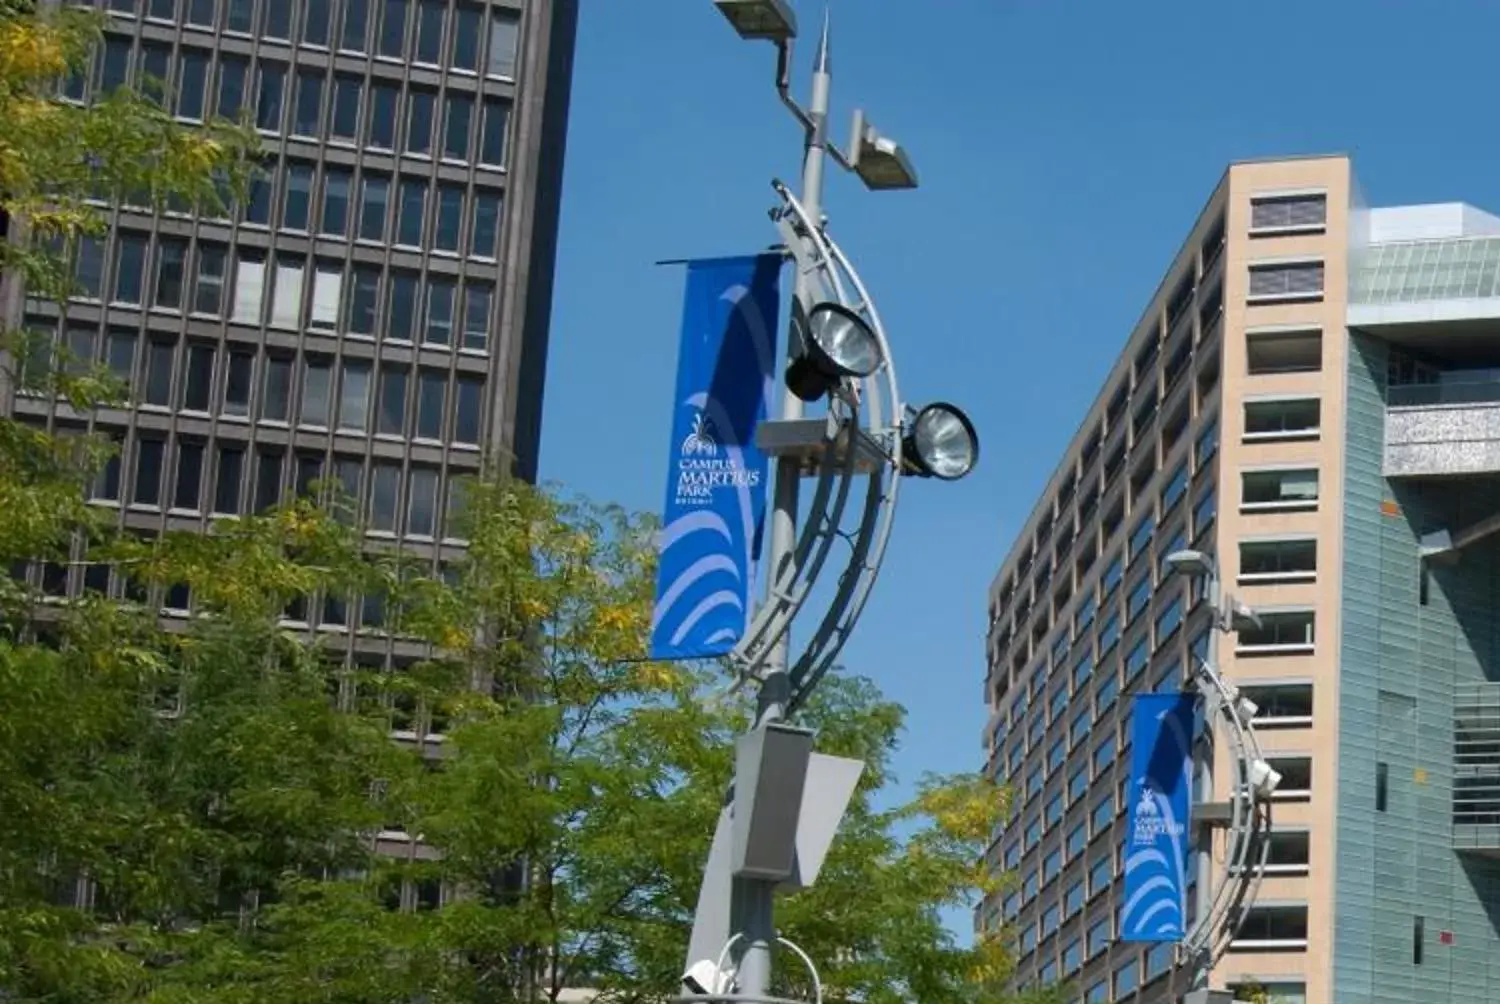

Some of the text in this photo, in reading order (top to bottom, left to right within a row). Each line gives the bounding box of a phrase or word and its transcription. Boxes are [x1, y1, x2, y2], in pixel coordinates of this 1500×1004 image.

[679, 459, 737, 470] CAMPUS
[679, 470, 760, 487] MARTIUS
[677, 484, 713, 497] PARK
